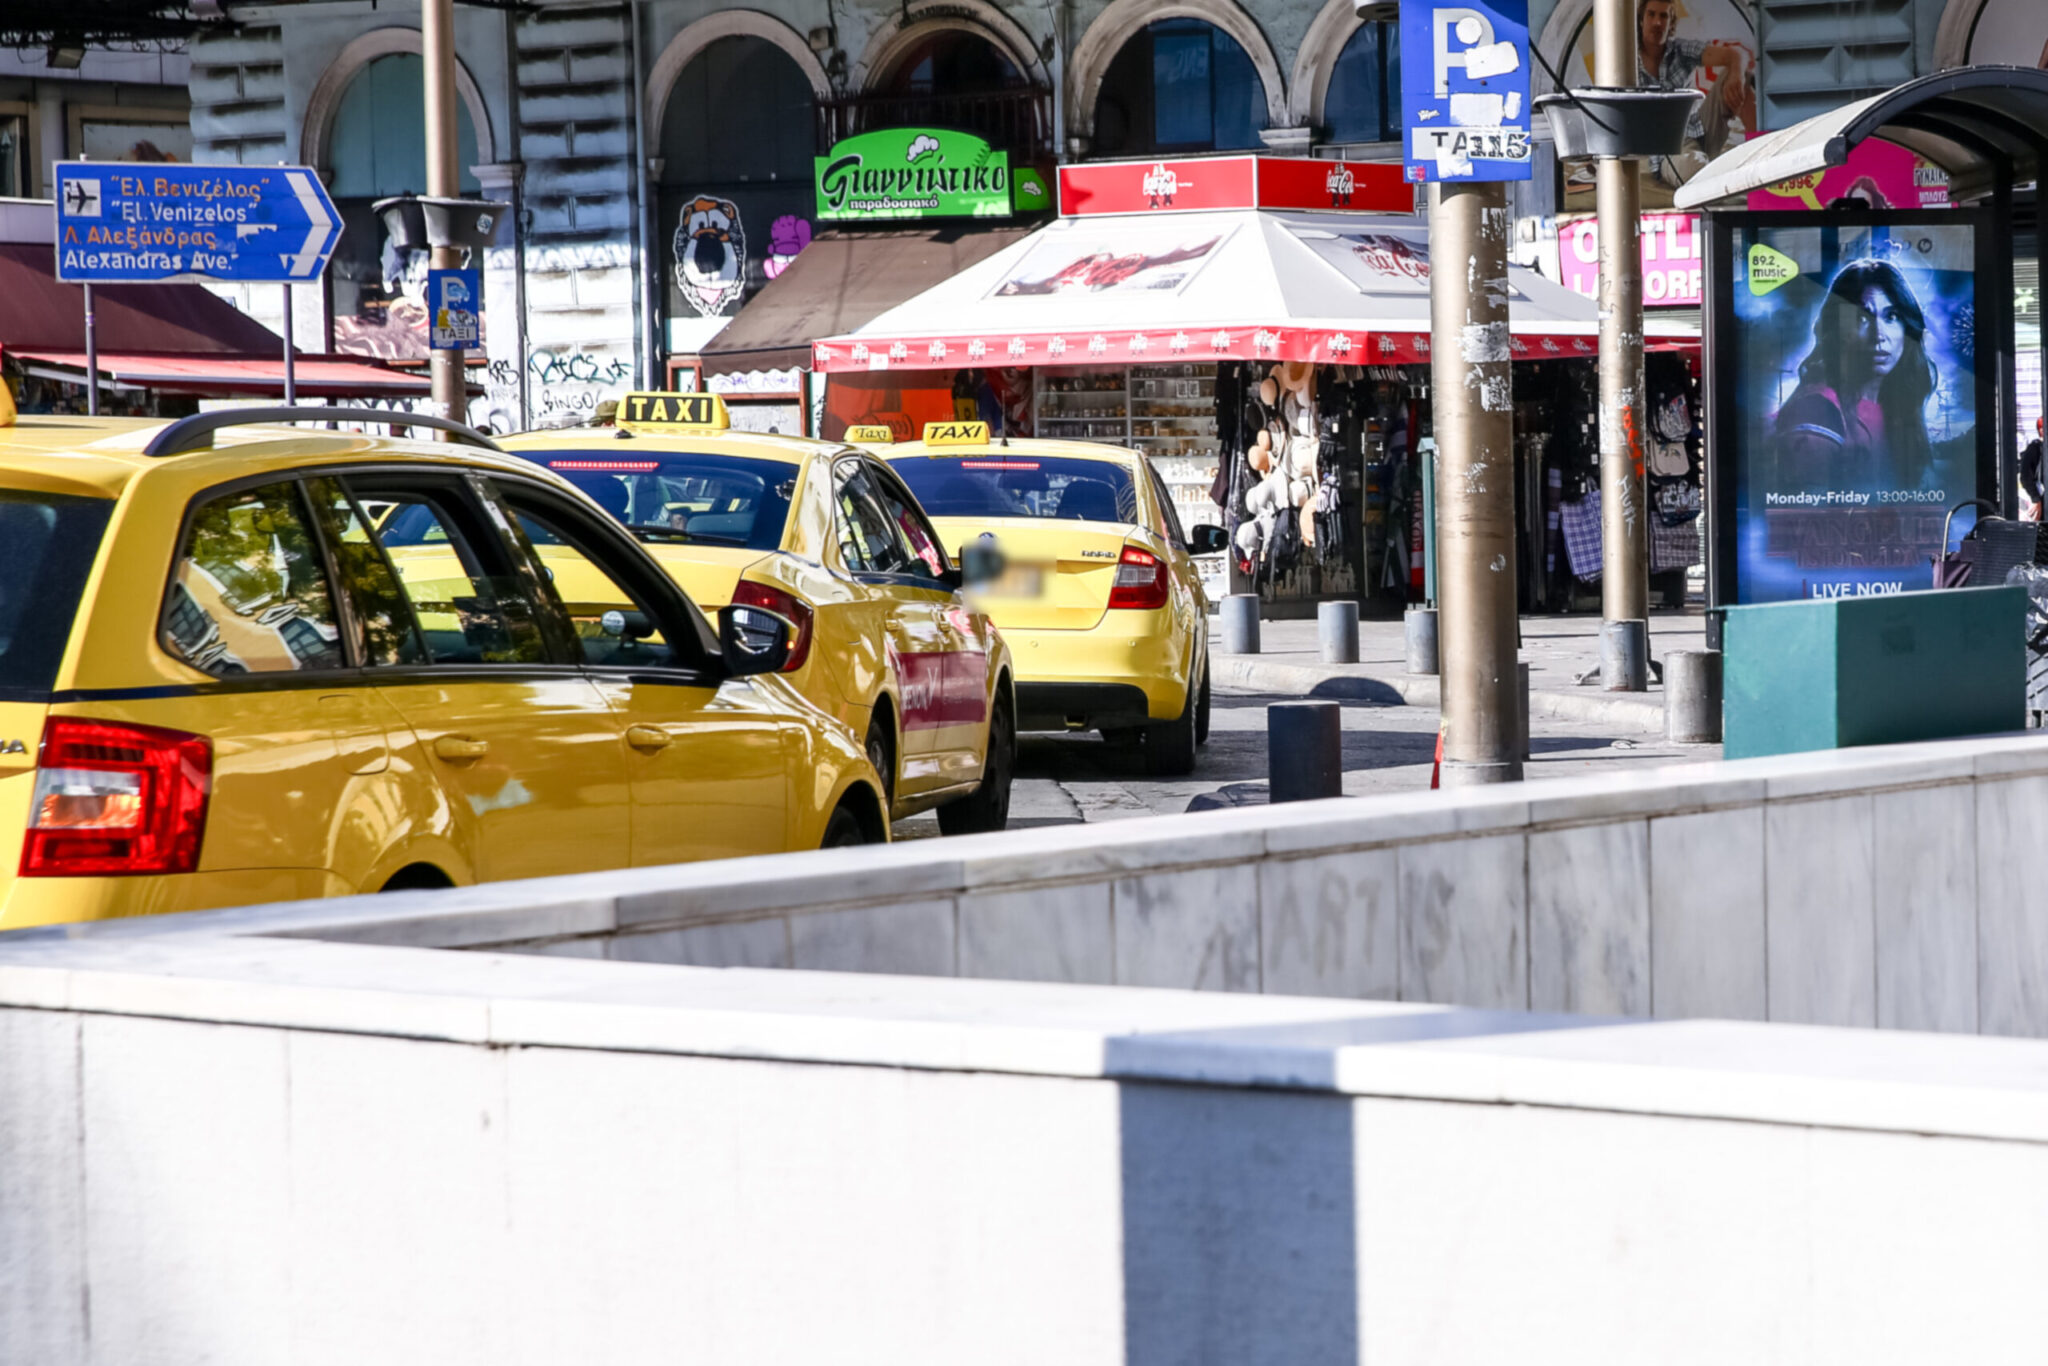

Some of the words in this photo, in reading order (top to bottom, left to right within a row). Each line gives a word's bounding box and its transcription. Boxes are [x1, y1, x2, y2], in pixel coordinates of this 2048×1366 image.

[1433, 8, 1495, 99] P
[850, 195, 938, 212] παραδοσιακό
[87, 225, 216, 250] Αλεξάνδρας
[64, 249, 182, 270] Alexandras
[1752, 256, 1776, 266] 89.2
[1753, 264, 1787, 278] music
[441, 277, 468, 311] P
[440, 328, 471, 339] ΤΑΞΙ
[631, 397, 708, 421] TAXI
[856, 427, 887, 440] Taxi
[929, 424, 983, 440] TAXI
[1766, 491, 1870, 506] Monday-Friday
[1876, 490, 1945, 503] 13:00-16:00
[1812, 582, 1851, 599] LIVE
[1857, 582, 1903, 597] NOW
